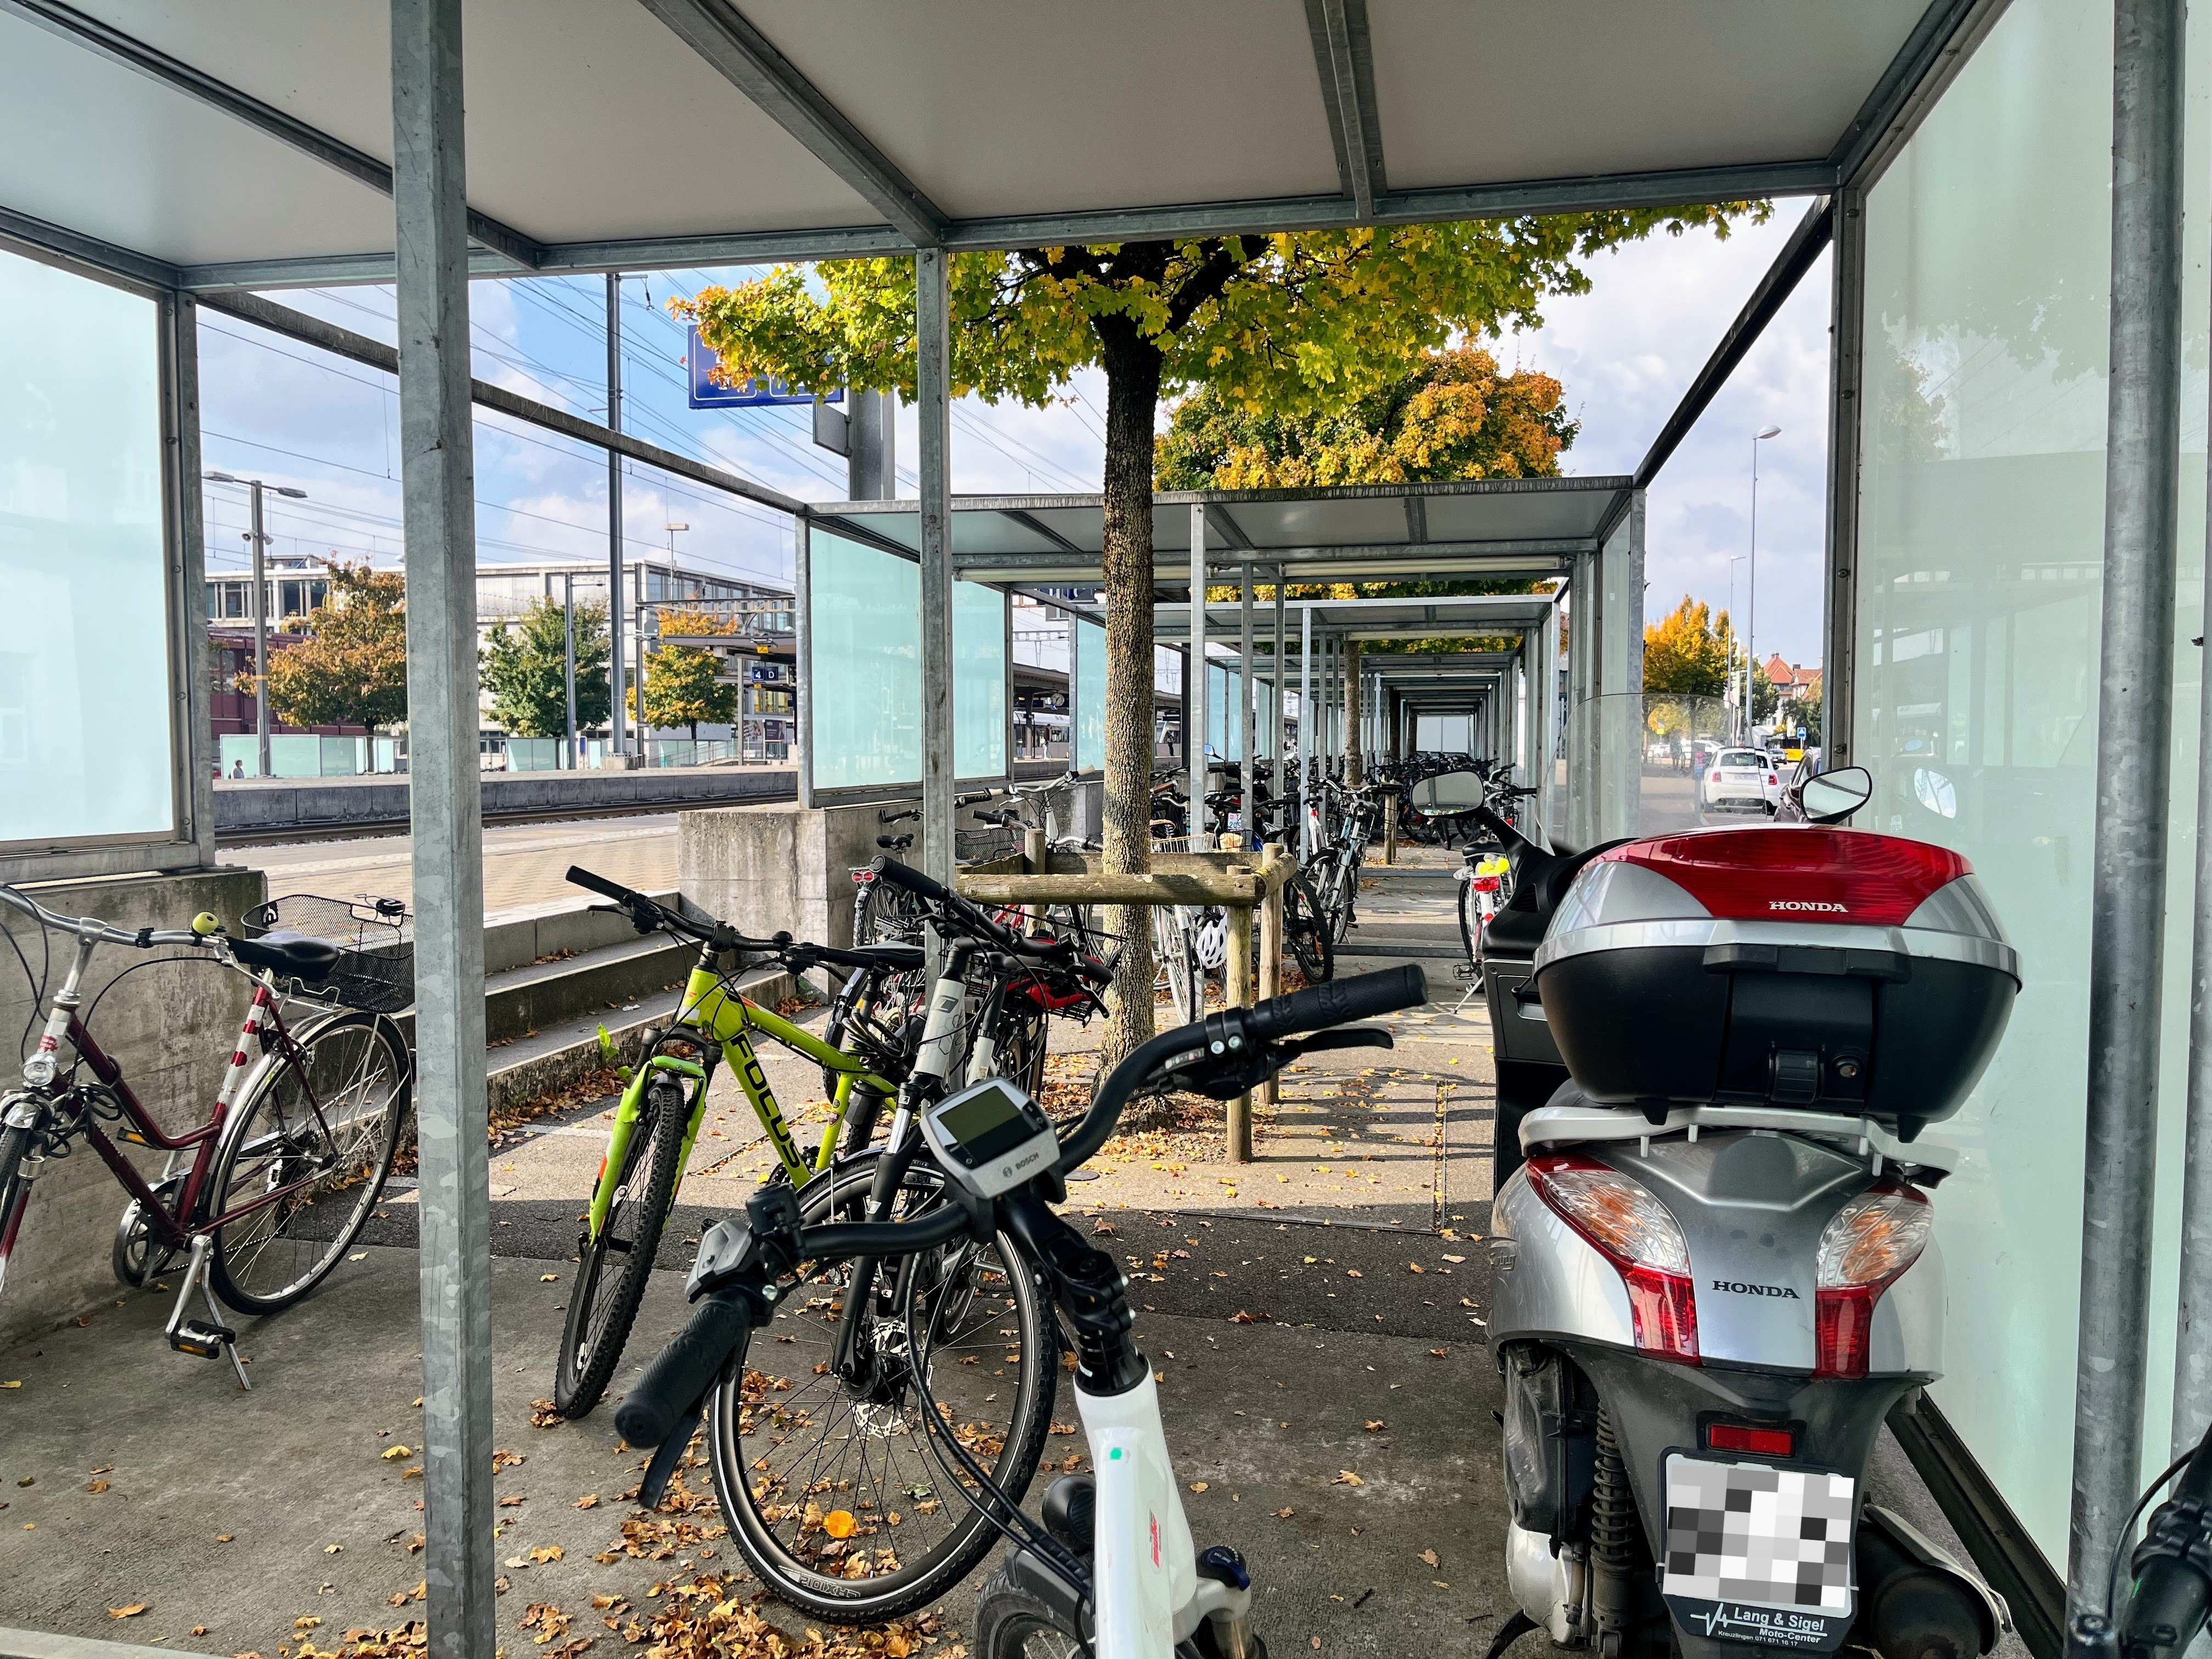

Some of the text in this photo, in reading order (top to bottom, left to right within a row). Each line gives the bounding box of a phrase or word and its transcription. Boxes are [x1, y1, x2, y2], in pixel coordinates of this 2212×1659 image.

[1769, 901, 1849, 913] HONDA
[730, 1032, 800, 1169] FOCUS
[1015, 1152, 1040, 1170] BOSCH
[1712, 1280, 1801, 1299] HONDA
[1734, 1607, 1825, 1632] Lang & Sigel
[1718, 1630, 1754, 1640] Kreuzlingen
[1759, 1627, 1821, 1644] Moto-Center
